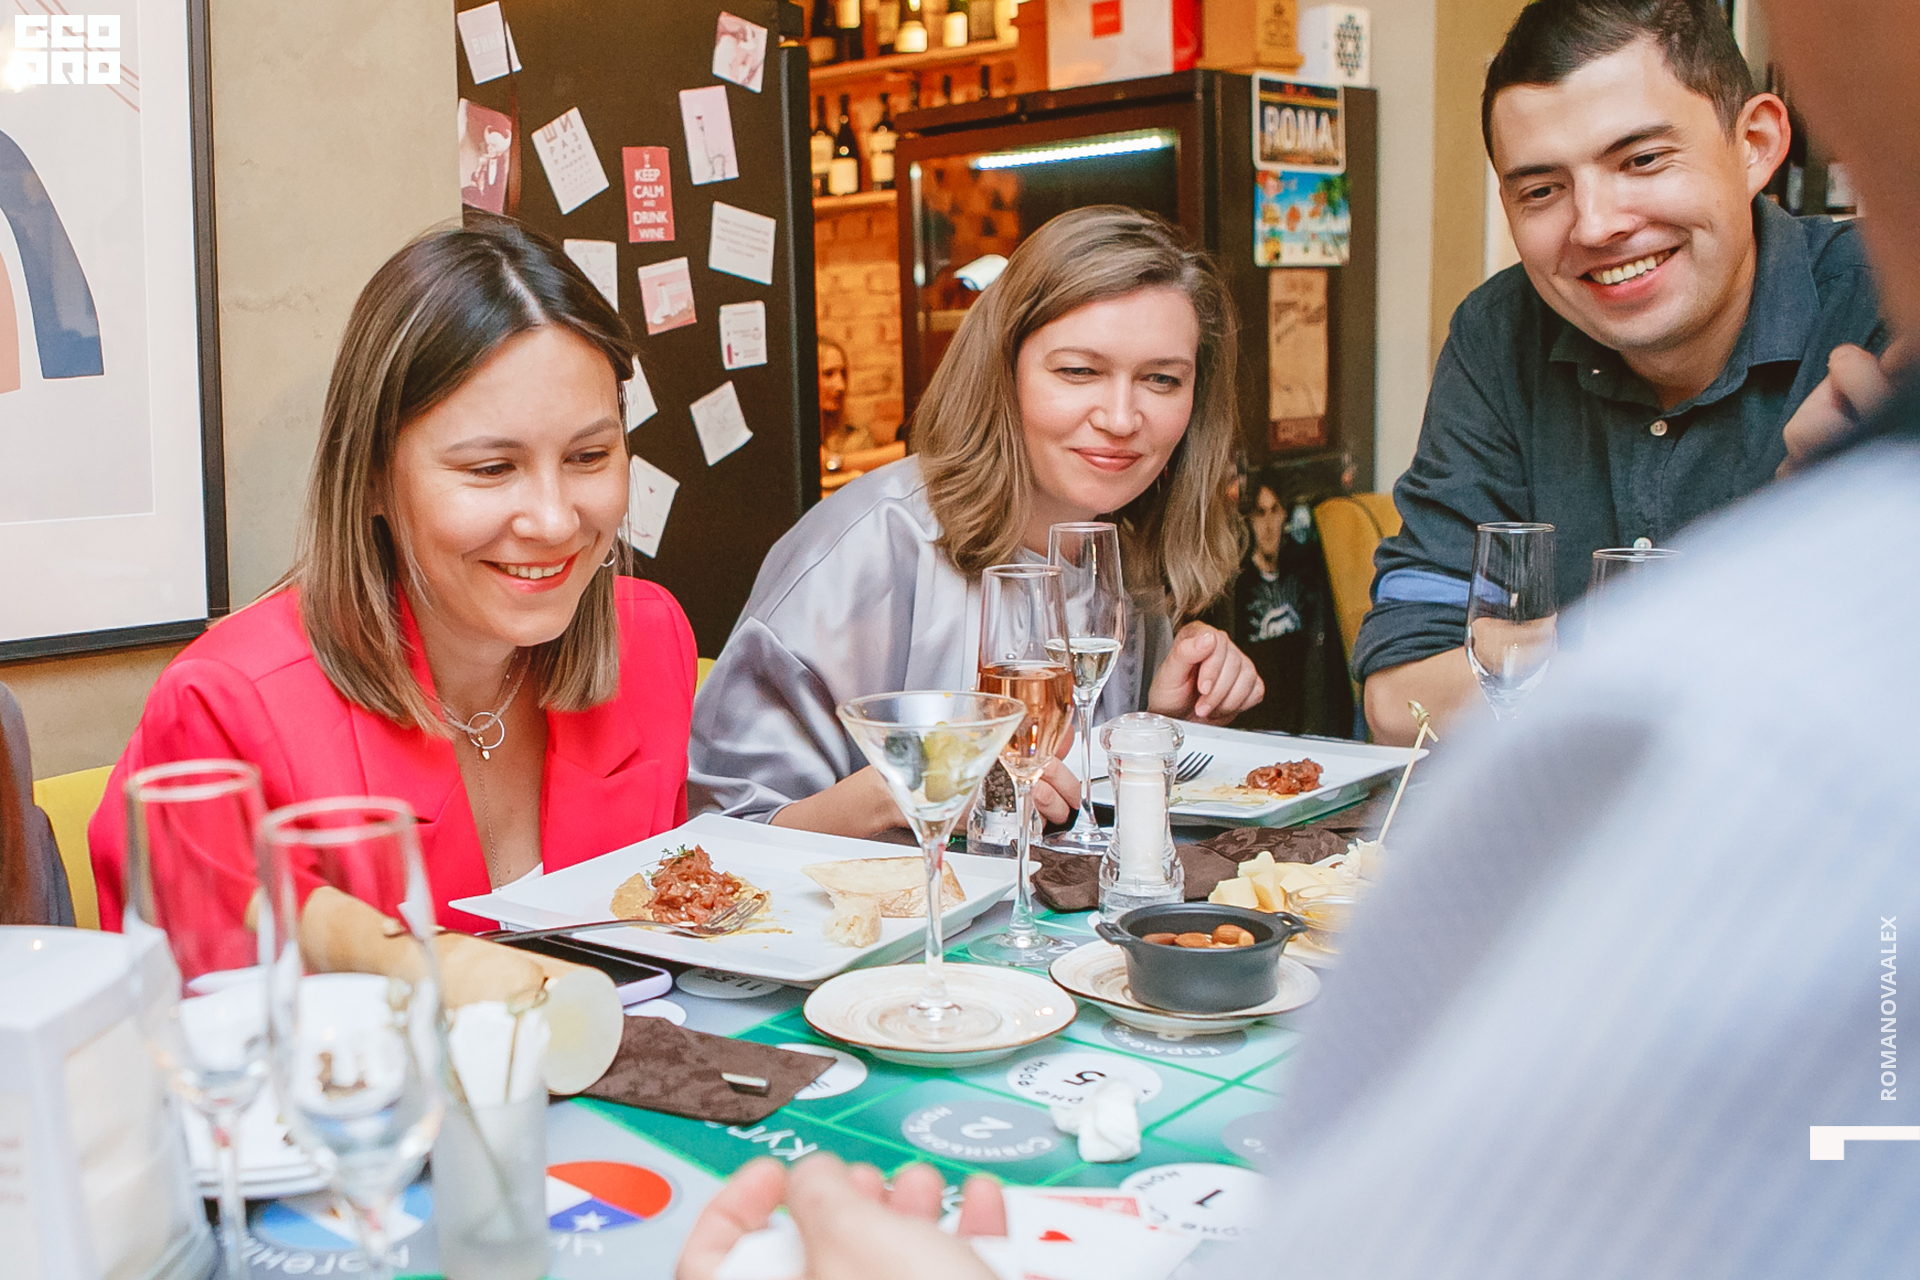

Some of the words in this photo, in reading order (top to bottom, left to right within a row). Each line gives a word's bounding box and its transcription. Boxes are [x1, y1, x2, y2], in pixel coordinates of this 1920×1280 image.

[1263, 105, 1334, 153] ROMA
[633, 168, 661, 183] KEEP
[632, 184, 665, 199] CALM
[632, 210, 669, 225] DRINK
[638, 227, 665, 239] WINE
[1063, 1070, 1107, 1086] 5
[960, 1115, 1013, 1139] 2
